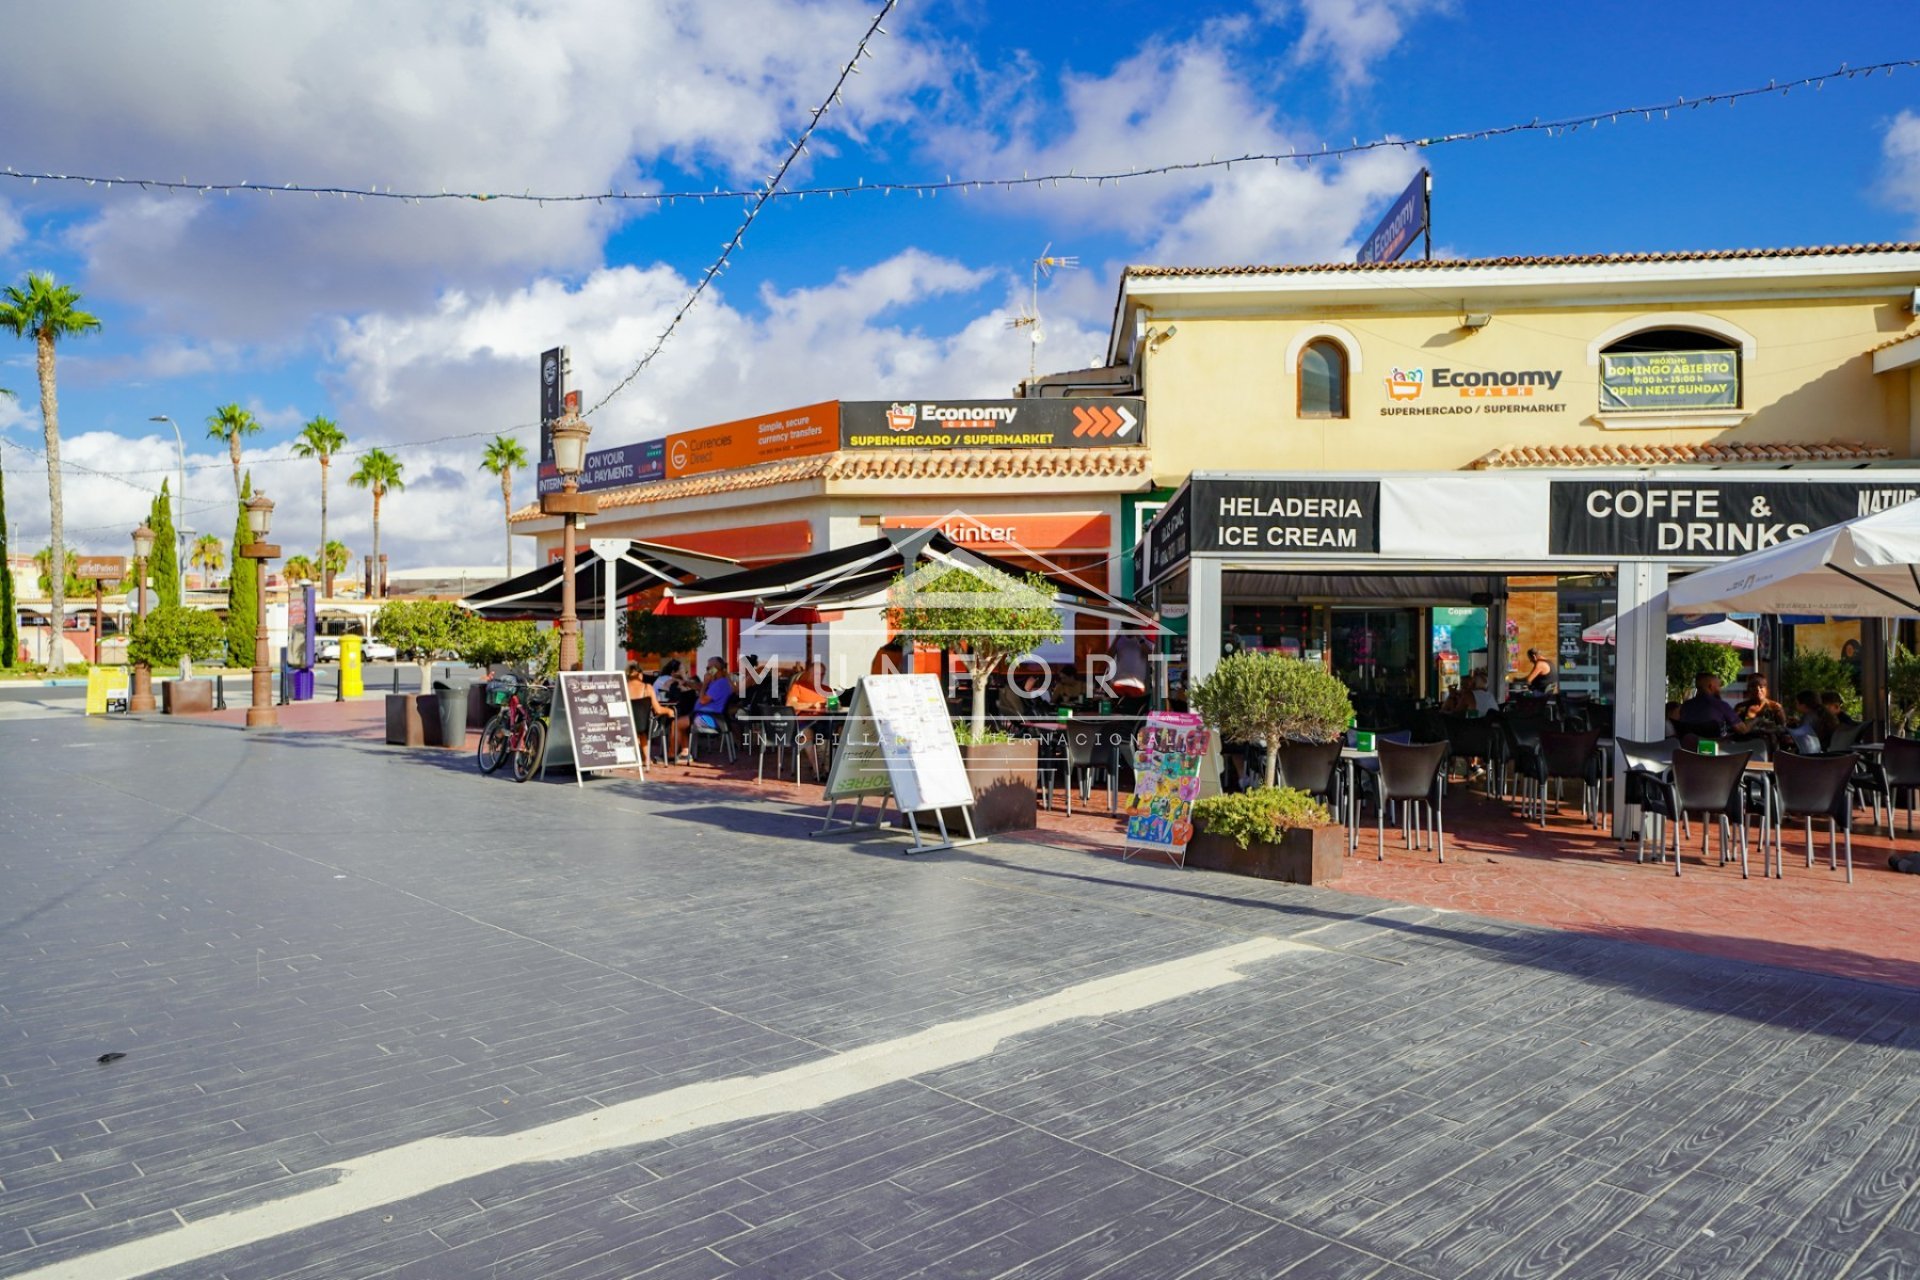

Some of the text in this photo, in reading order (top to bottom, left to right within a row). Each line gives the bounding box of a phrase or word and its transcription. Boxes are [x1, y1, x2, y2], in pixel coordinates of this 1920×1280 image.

[1374, 195, 1415, 261] Economy
[1432, 368, 1563, 390] Economy
[1608, 363, 1729, 376] DOMINGO ABIERTO
[1469, 388, 1525, 397] CASH
[1611, 384, 1728, 396] OPEN NEXT SUNDAY
[921, 405, 1018, 424] Economy
[1380, 406, 1473, 416] SUPERMERCADO
[1484, 404, 1567, 414] SUPERMARKET
[758, 415, 810, 434] Simple, secure
[690, 434, 733, 452] Currencies
[758, 426, 823, 445] currency transfers
[850, 435, 951, 446] SUPERMERCADO
[963, 433, 1054, 445] SUPERMARKET
[588, 451, 625, 469] ON YOUR
[690, 451, 713, 465] Direct
[539, 470, 593, 492] INTERNNAL
[594, 464, 634, 483] PAYMENTS
[1219, 497, 1363, 518] HELADERIA
[1586, 490, 1773, 518] COFFE &
[1218, 526, 1357, 547] ICE CREAM
